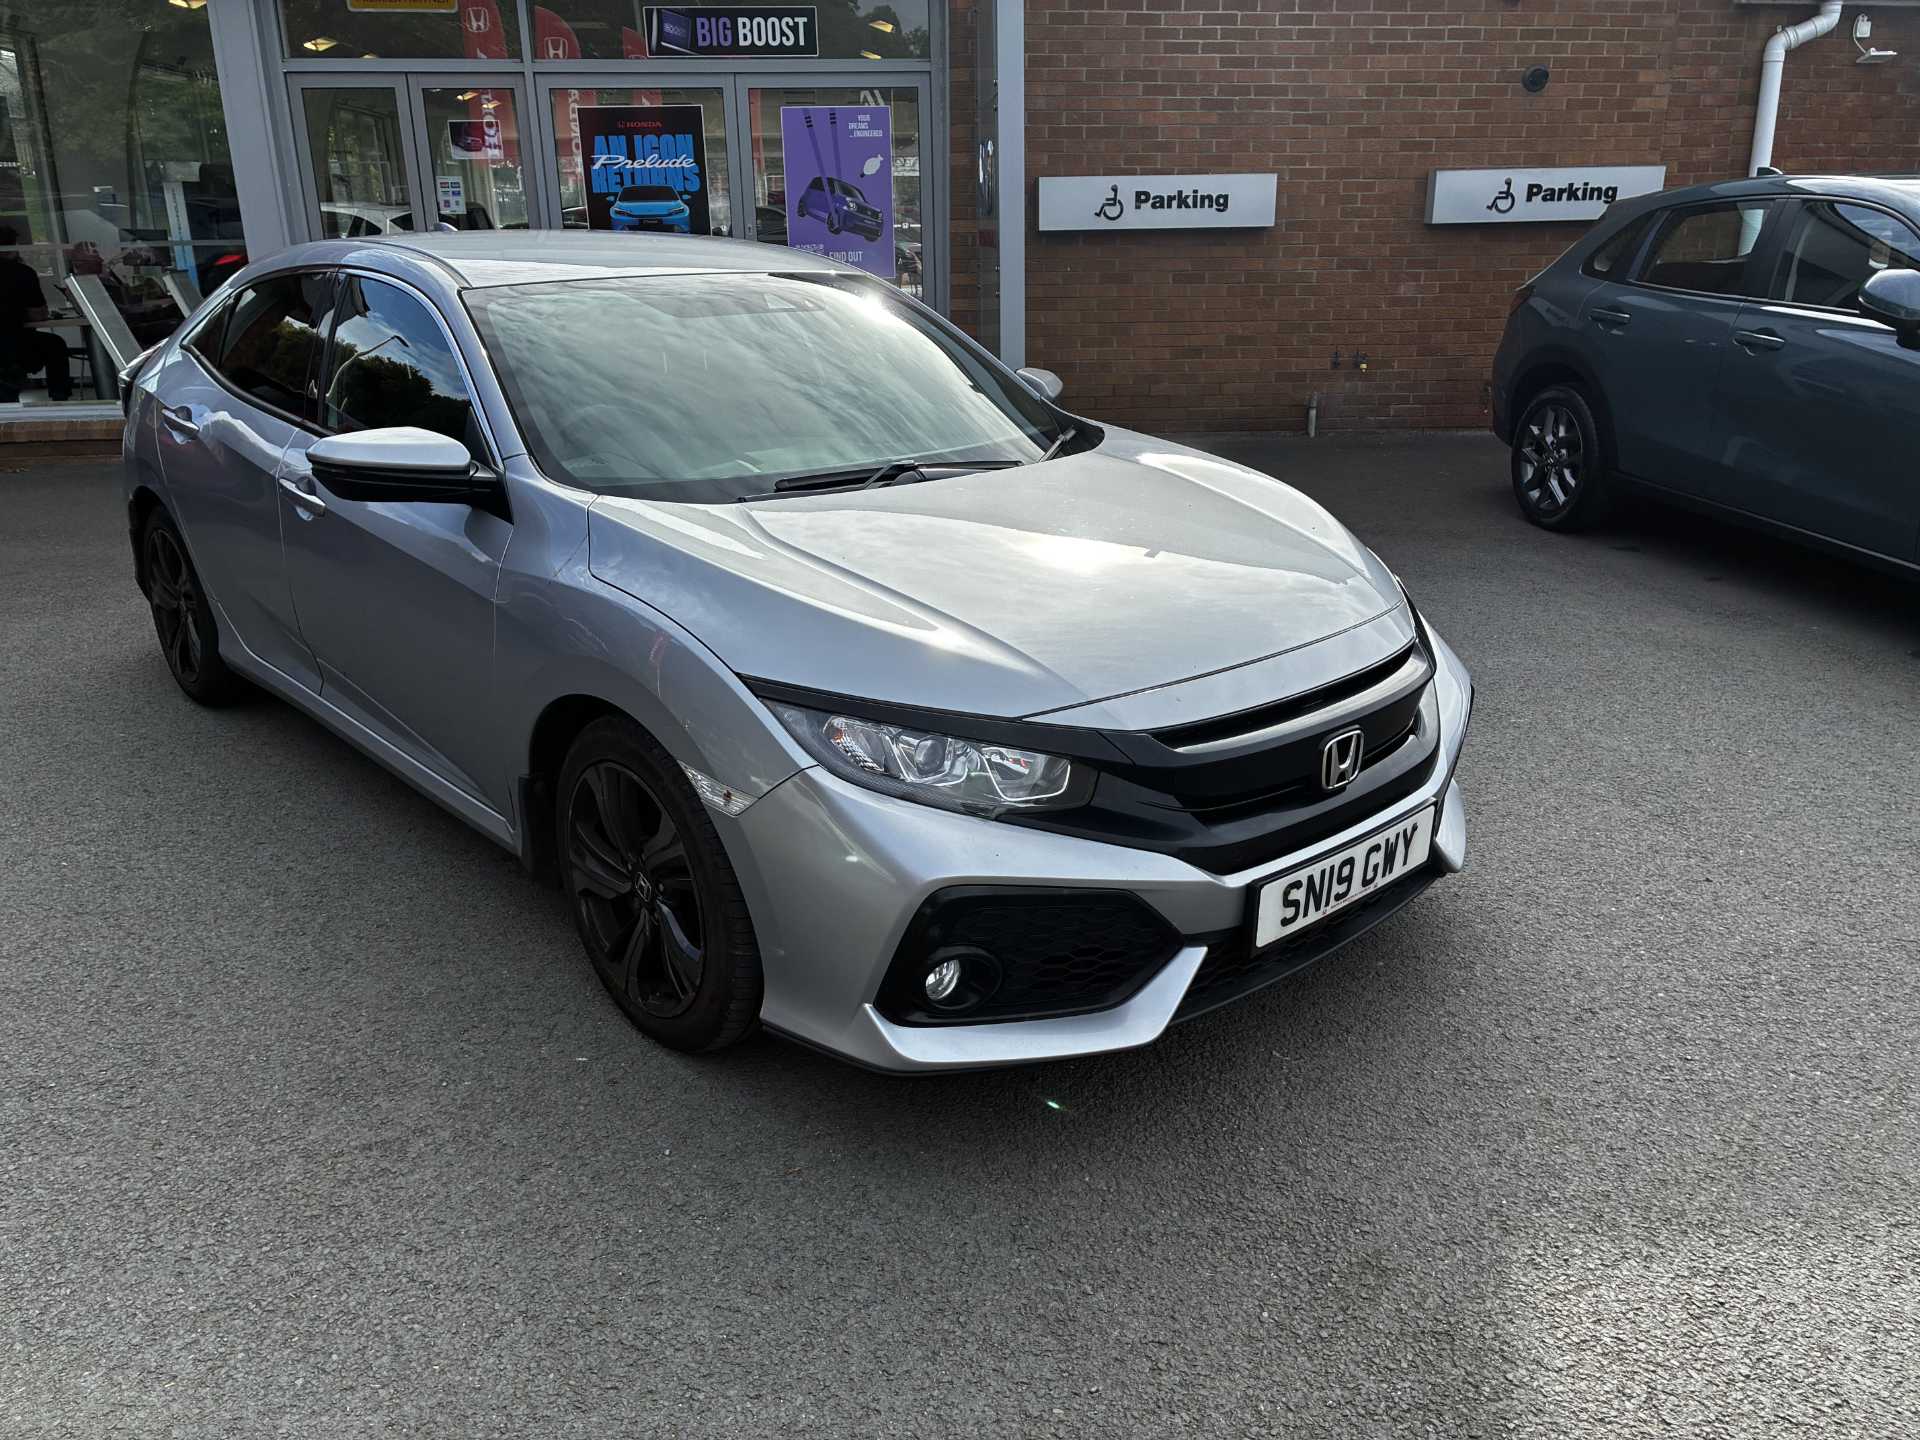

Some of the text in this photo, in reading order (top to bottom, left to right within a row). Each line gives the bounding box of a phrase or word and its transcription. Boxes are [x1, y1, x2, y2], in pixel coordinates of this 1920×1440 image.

[695, 17, 733, 47] BIG
[737, 16, 808, 47] BOOST
[626, 120, 663, 128] HONDA
[591, 153, 697, 170] Prelude
[594, 134, 695, 165] AN ICON
[591, 165, 701, 193] RETURNS
[1134, 188, 1229, 214] Parking
[1526, 181, 1619, 204] Parking
[847, 250, 864, 262] OUT
[1280, 822, 1419, 927] SN19 GWY
